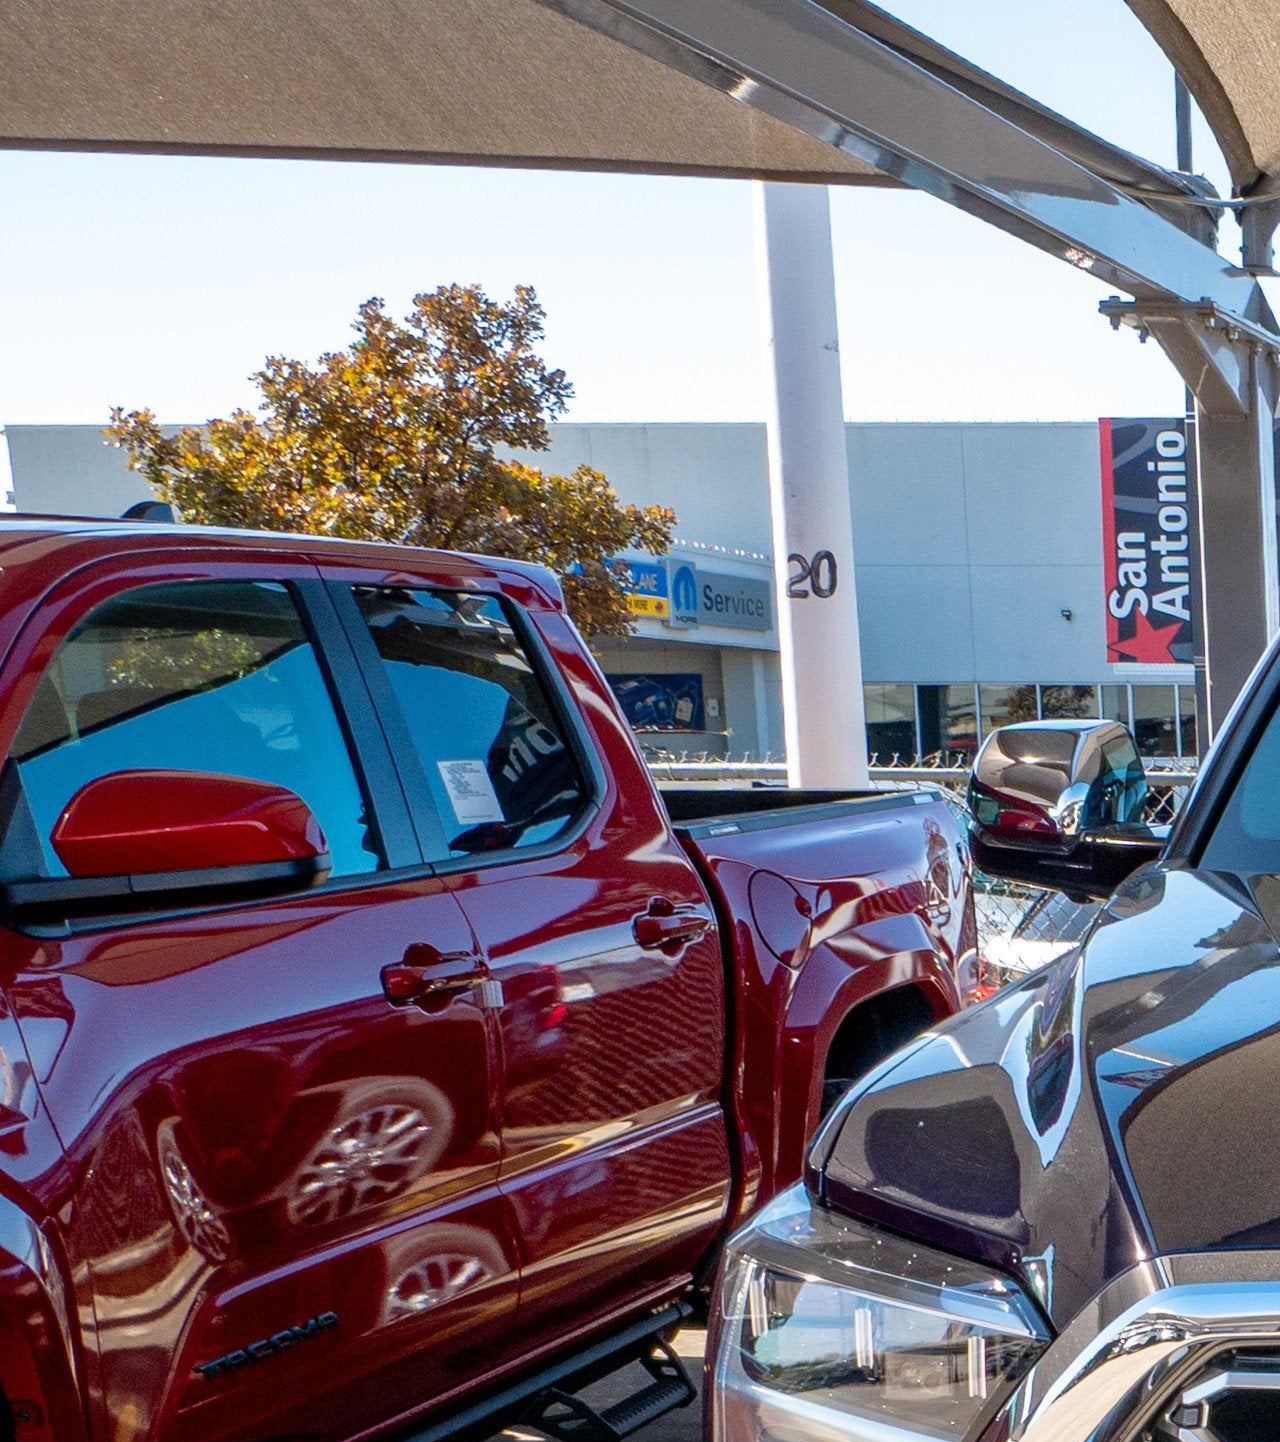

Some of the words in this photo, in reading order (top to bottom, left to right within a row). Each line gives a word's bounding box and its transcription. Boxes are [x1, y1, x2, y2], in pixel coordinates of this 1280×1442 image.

[1147, 430, 1191, 621] Antonio
[703, 584, 764, 617] Service
[786, 550, 837, 599] 20
[1108, 531, 1149, 619] San
[193, 1310, 341, 1380] TACOMA
